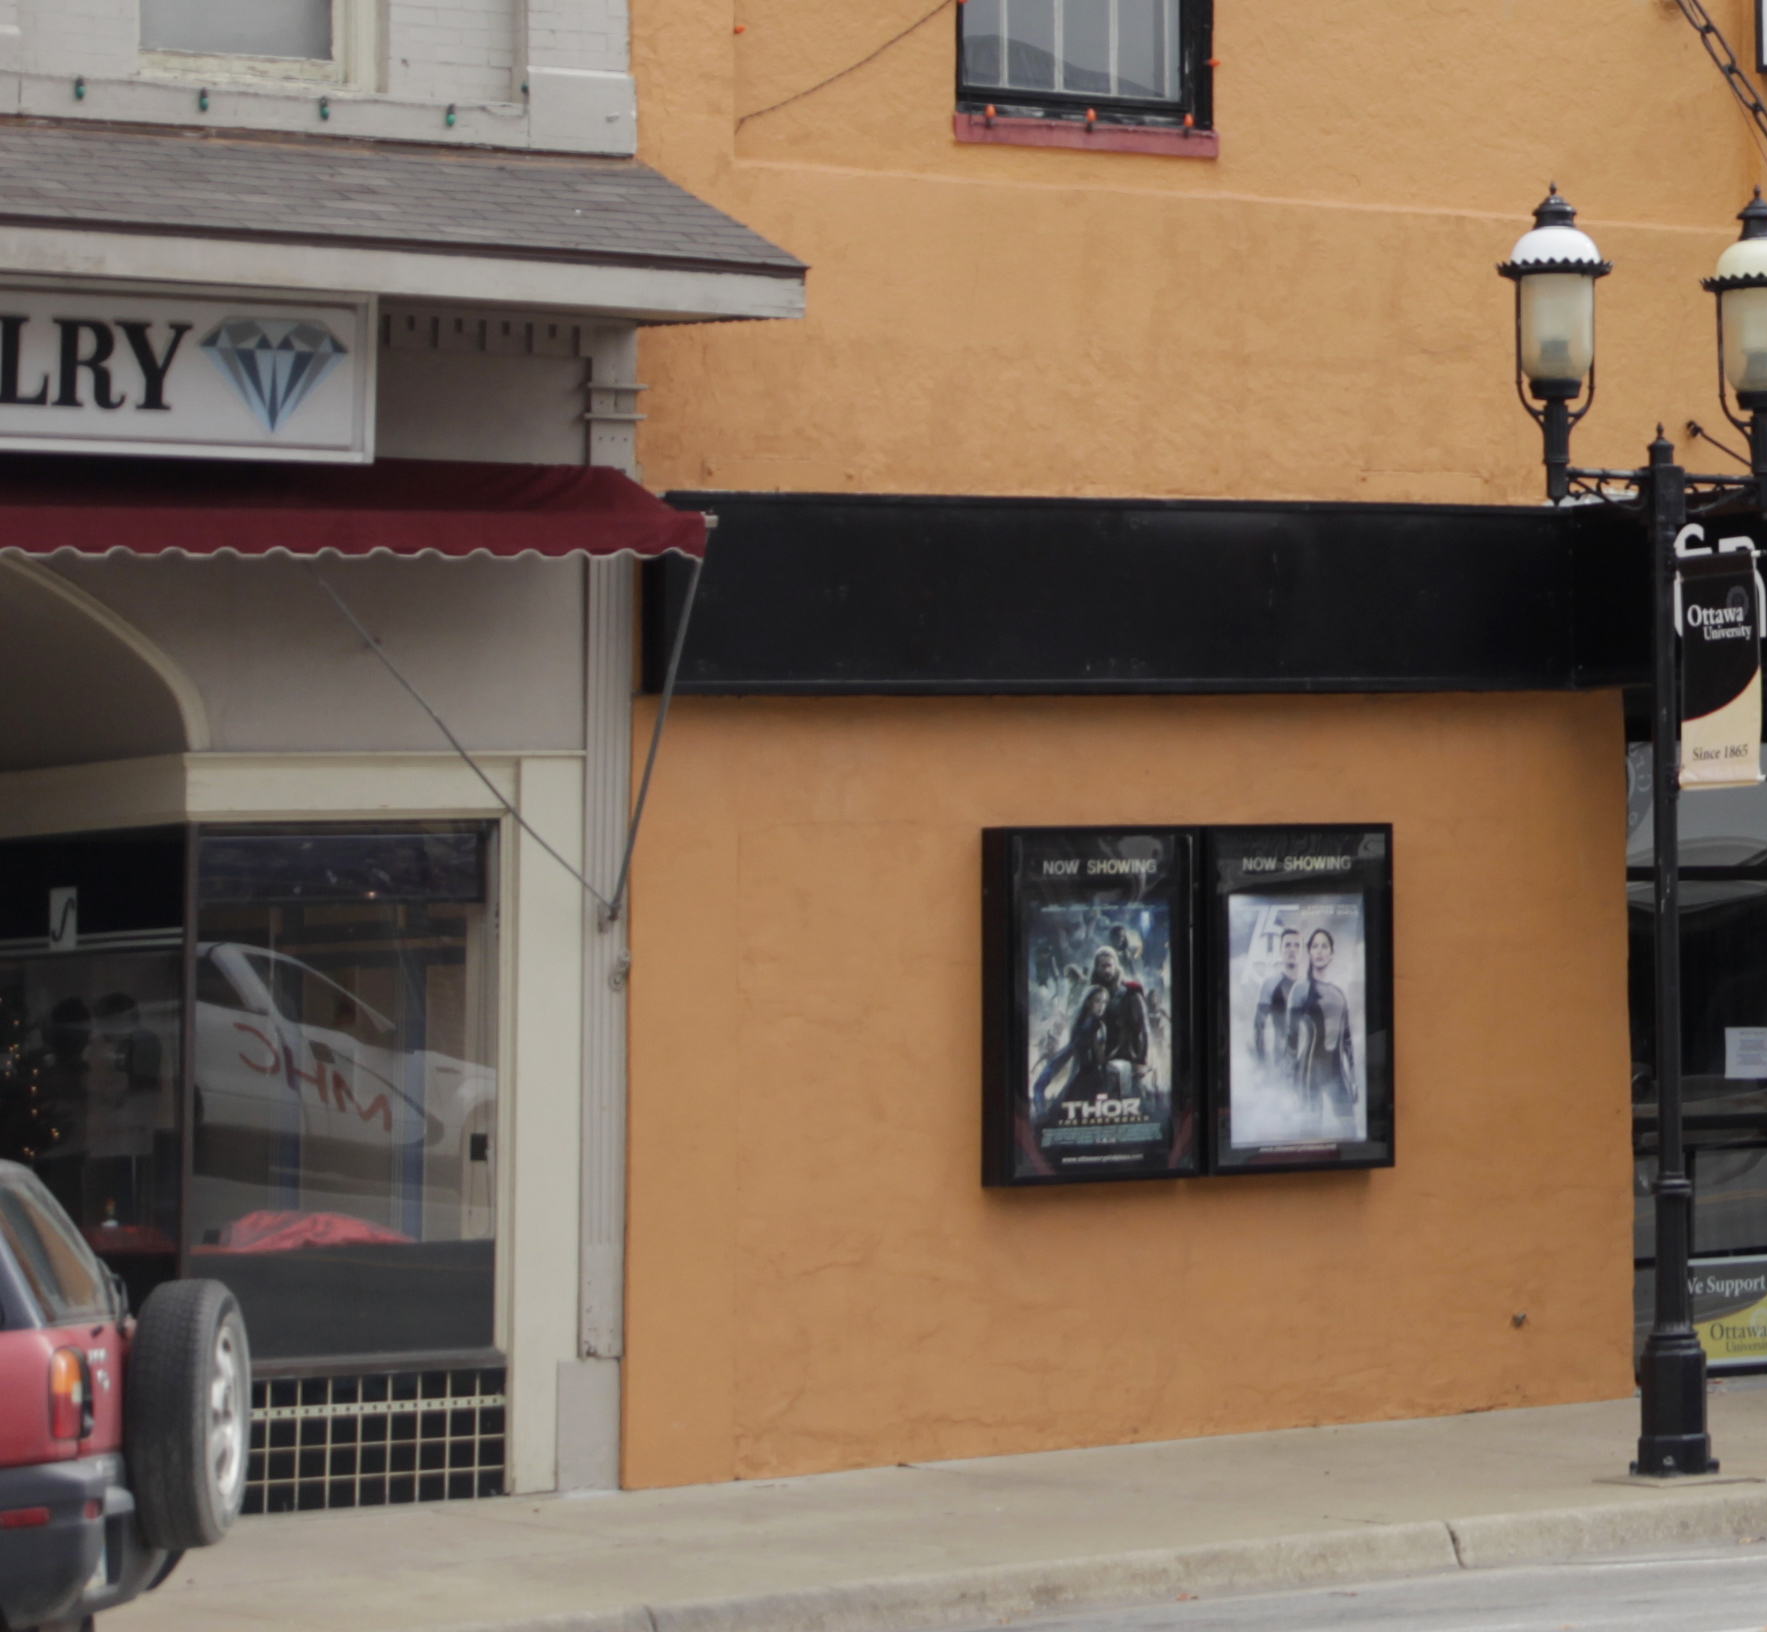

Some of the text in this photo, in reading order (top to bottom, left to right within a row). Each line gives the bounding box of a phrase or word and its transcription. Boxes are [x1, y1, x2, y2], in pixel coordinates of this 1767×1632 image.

[1687, 604, 1745, 627] Ottawa
[1704, 624, 1752, 642] University
[1692, 743, 1749, 762] Since 1865
[1042, 857, 1158, 877] NOW SHOWING
[1241, 854, 1352, 872] NOW SHOWING
[1061, 1097, 1141, 1119] THOR
[1706, 1274, 1766, 1298] Support
[1709, 1322, 1767, 1341] Ottawa
